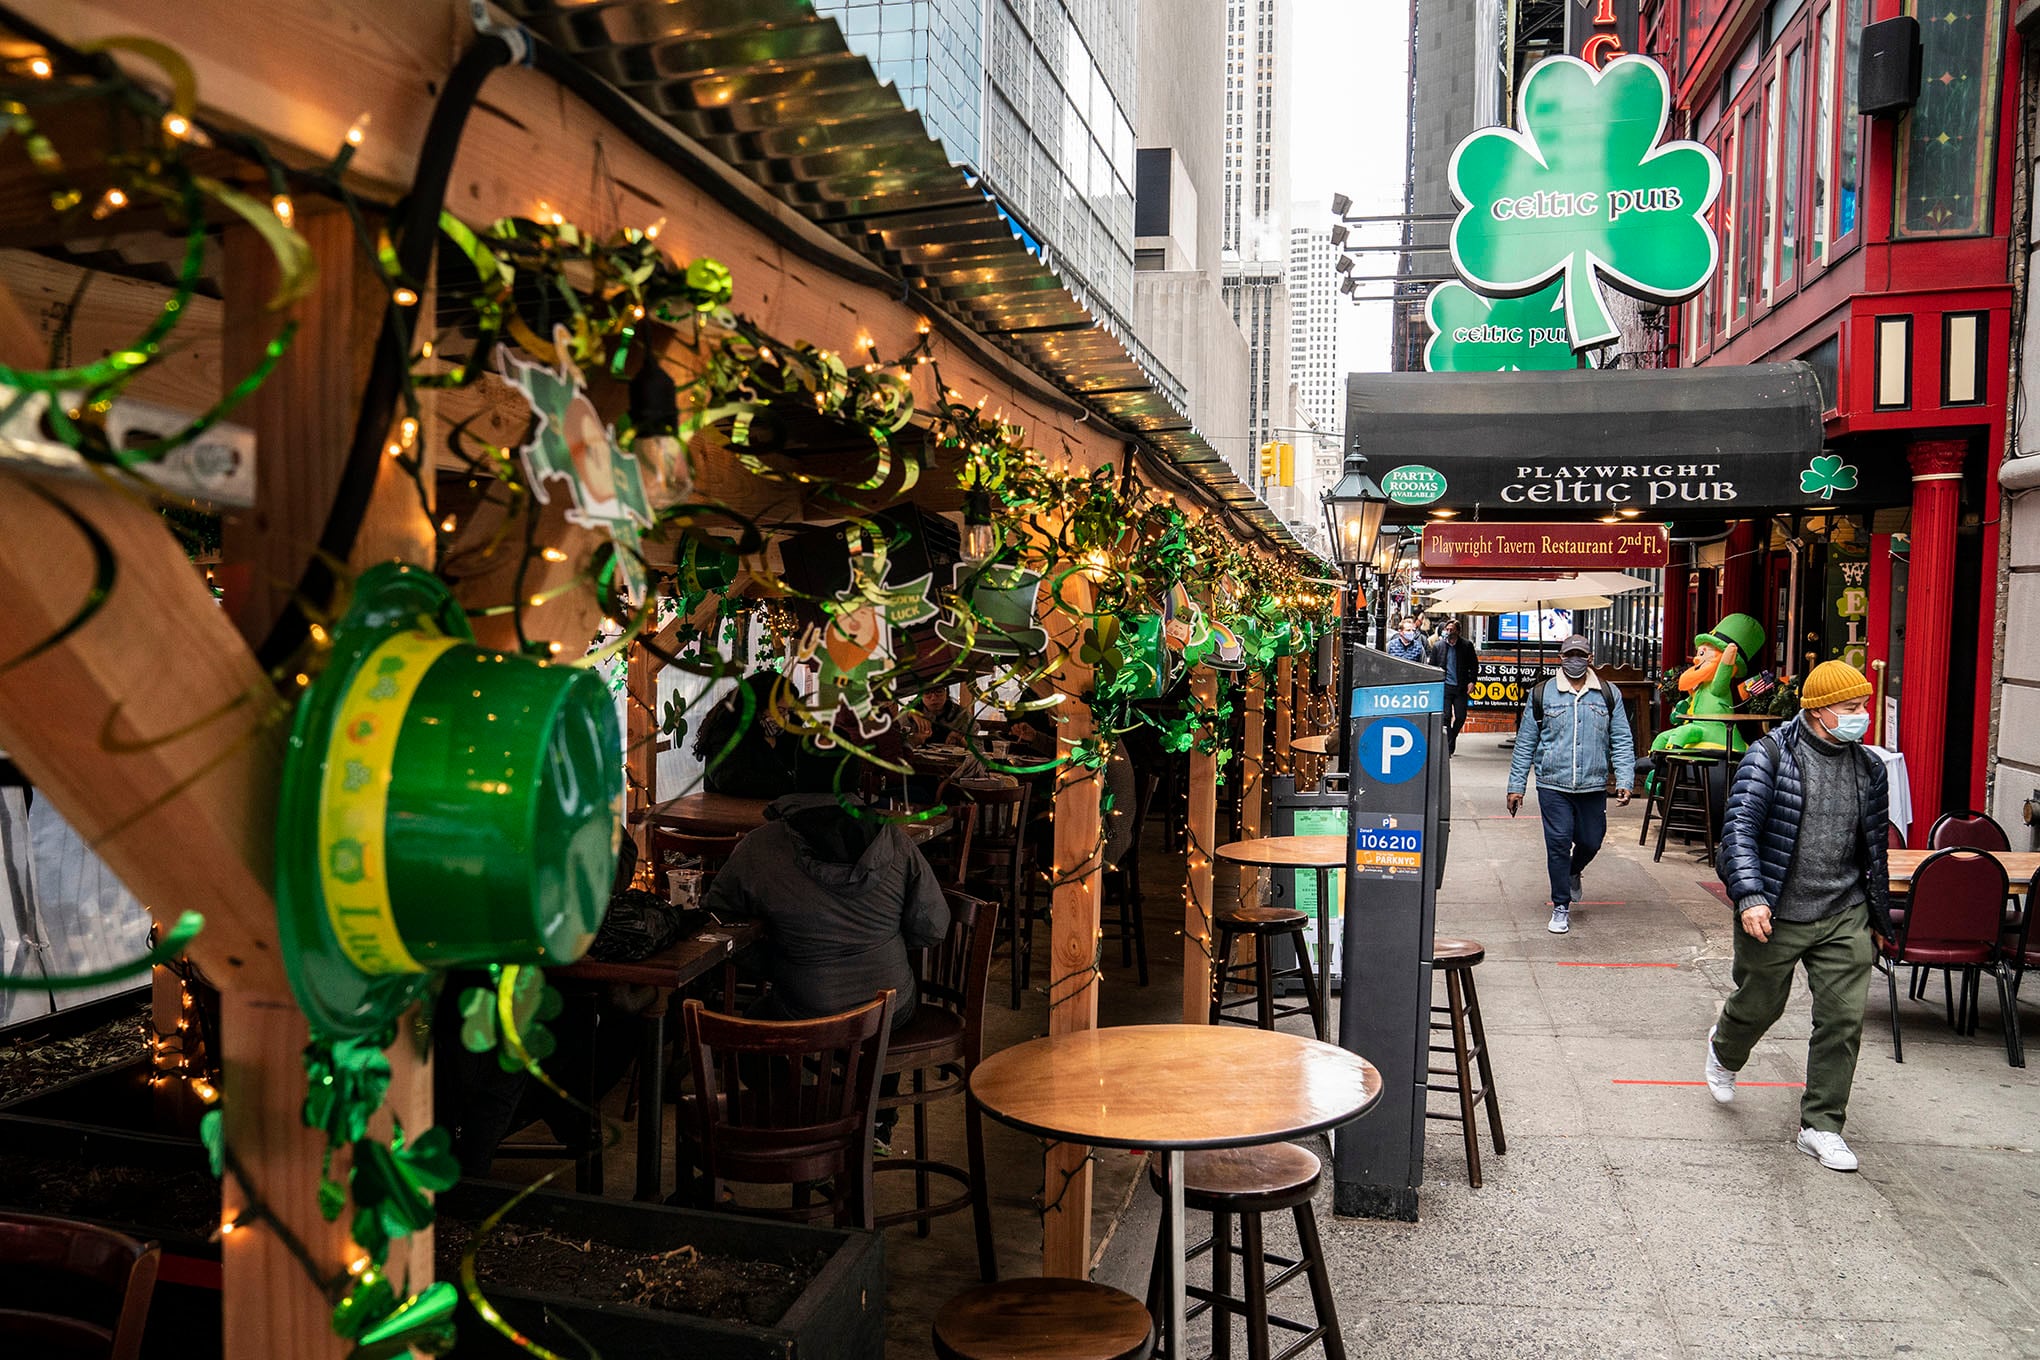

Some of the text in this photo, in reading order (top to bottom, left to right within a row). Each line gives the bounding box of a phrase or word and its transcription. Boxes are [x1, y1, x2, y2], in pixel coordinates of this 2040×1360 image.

[1393, 471, 1436, 481] PARTY
[1517, 464, 1720, 478] PLAYWRIGHT
[1390, 481, 1438, 491] ROOMS
[1432, 531, 1662, 558] Playwright Tavern Restaurant 2nd Fl.
[891, 605, 920, 620] LUCK
[1840, 562, 1868, 673] WELC
[1485, 665, 1496, 674] St
[1473, 687, 1482, 697] N
[1492, 687, 1501, 696] R
[1373, 694, 1429, 709] 106210
[1381, 726, 1413, 774] P
[1361, 835, 1416, 850] 106210
[1375, 855, 1415, 865] PARKNYC
